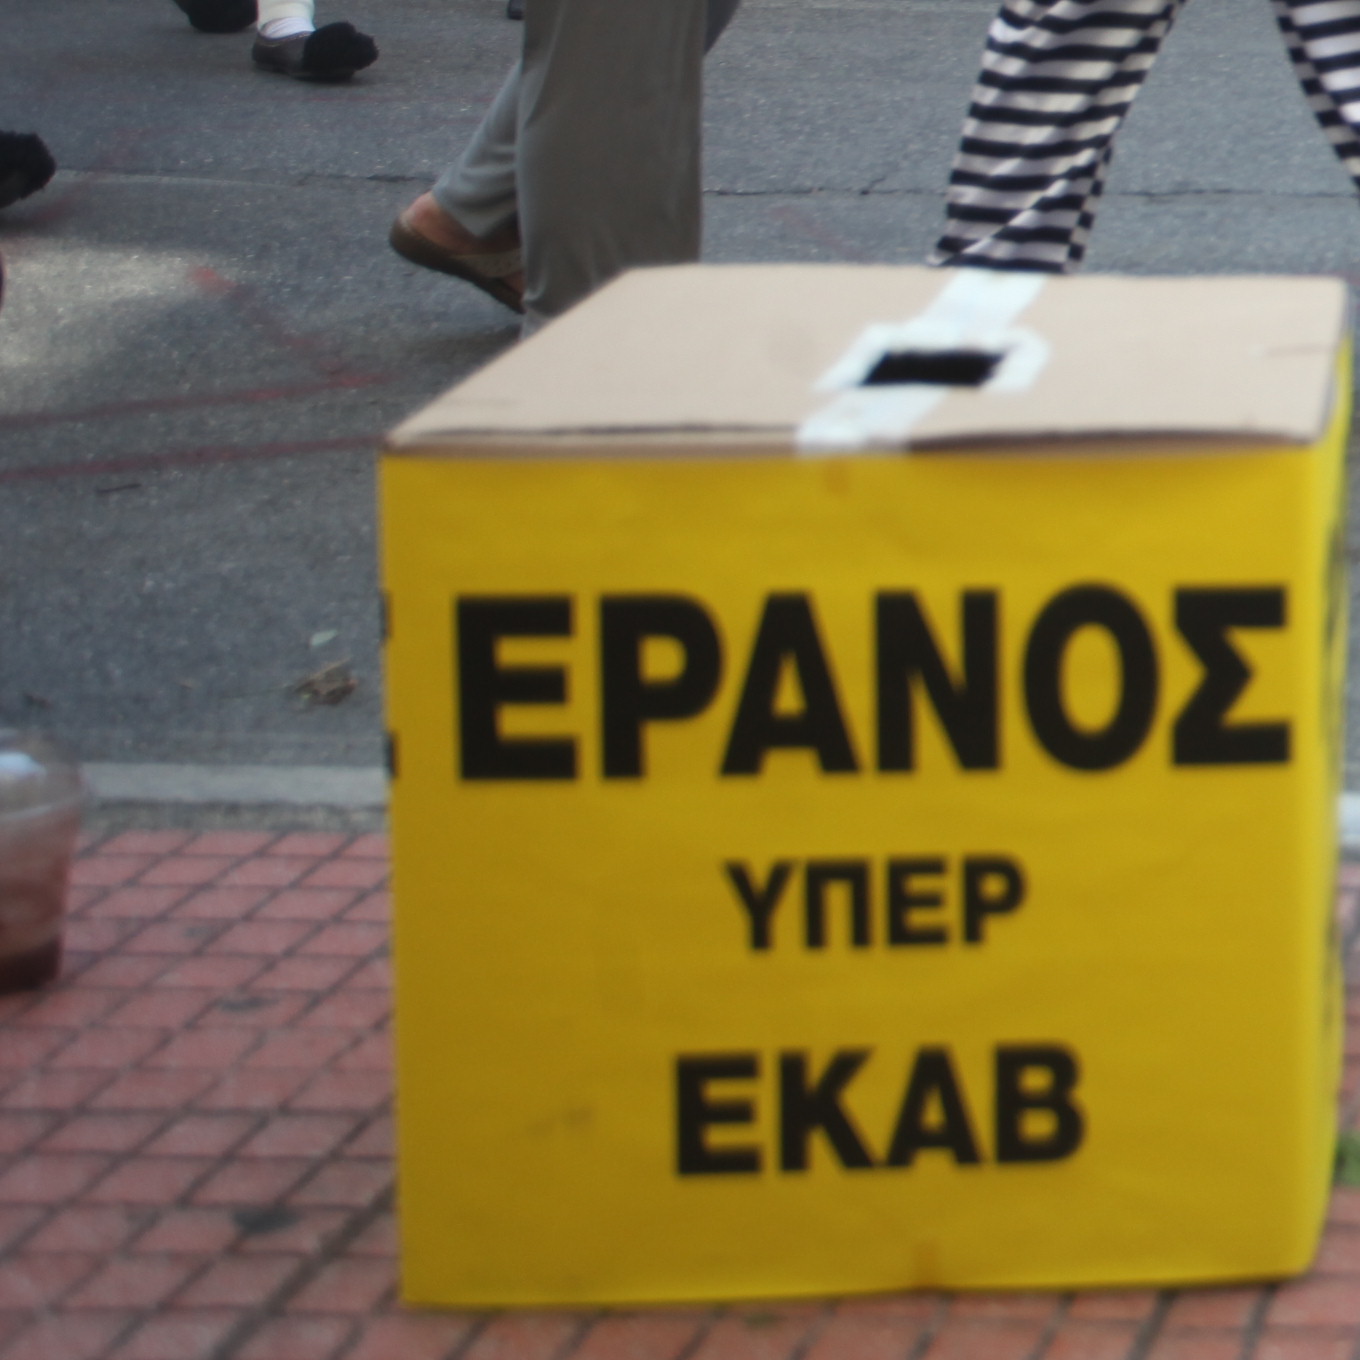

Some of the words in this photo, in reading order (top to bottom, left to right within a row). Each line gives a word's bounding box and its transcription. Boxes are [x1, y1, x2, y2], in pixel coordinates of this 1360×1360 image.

[453, 583, 1291, 783] ΕΡΑΝΟΣ
[724, 855, 1026, 952] ΥΠΕΡ
[673, 1043, 1085, 1178] ΕΚΑΒ
